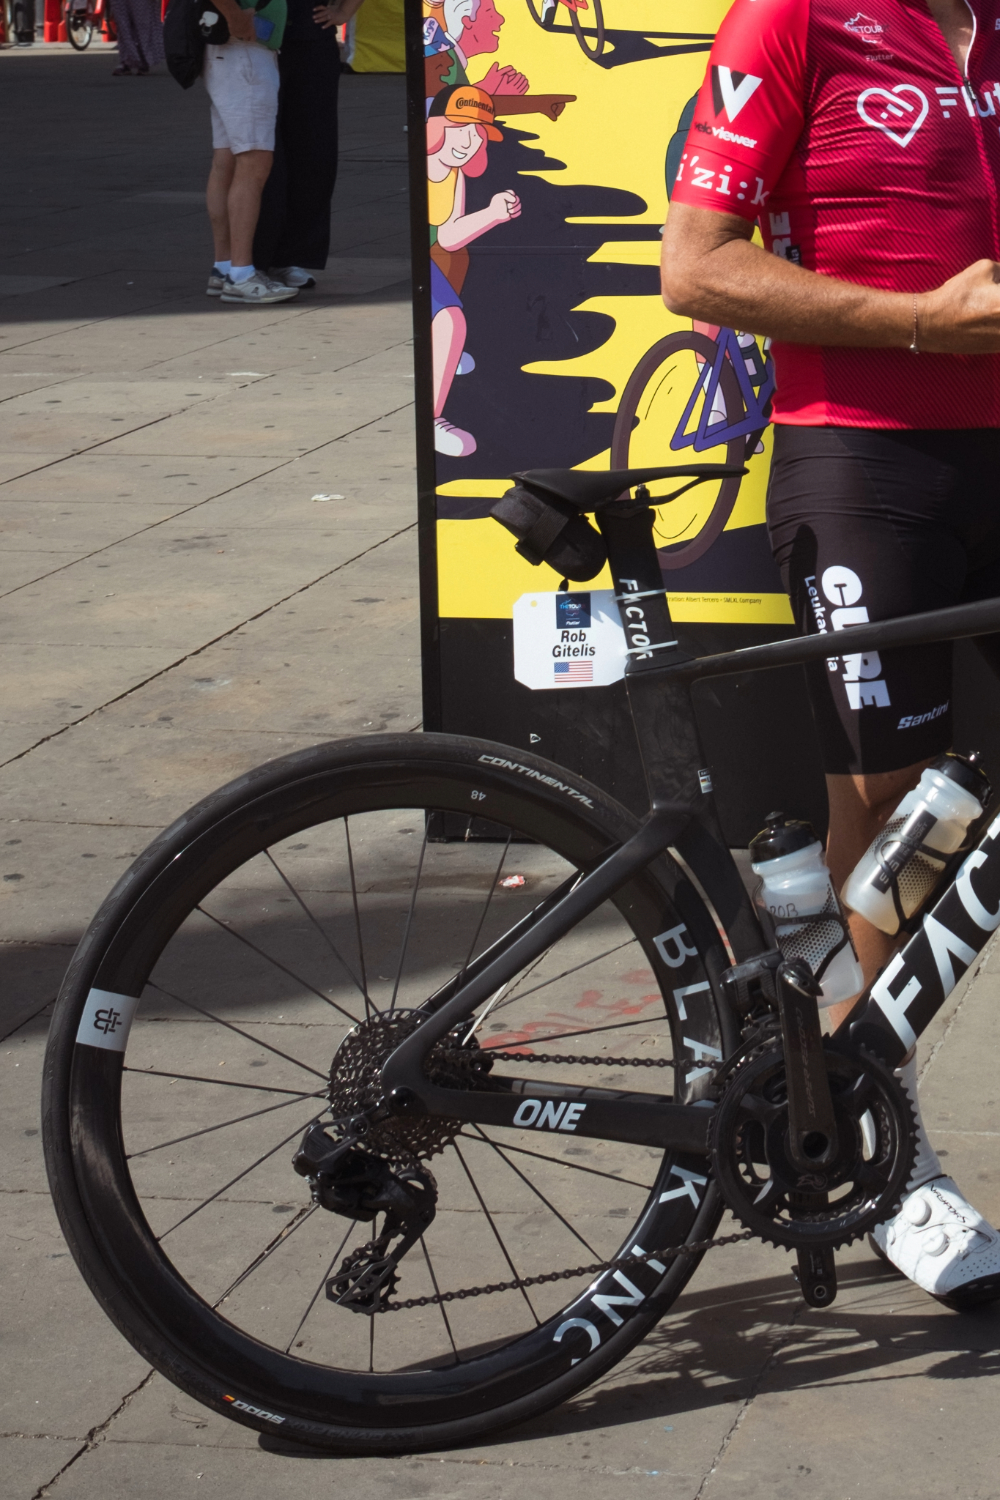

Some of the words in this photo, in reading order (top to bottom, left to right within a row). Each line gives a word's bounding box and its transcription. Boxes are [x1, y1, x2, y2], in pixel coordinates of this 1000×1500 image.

[560, 629, 587, 643] Rob
[551, 643, 596, 658] Gitelis
[897, 699, 950, 730] Santini
[478, 754, 595, 810] CONTINENTAL
[512, 1098, 587, 1132] ONE
[231, 1399, 287, 1425] 5000
